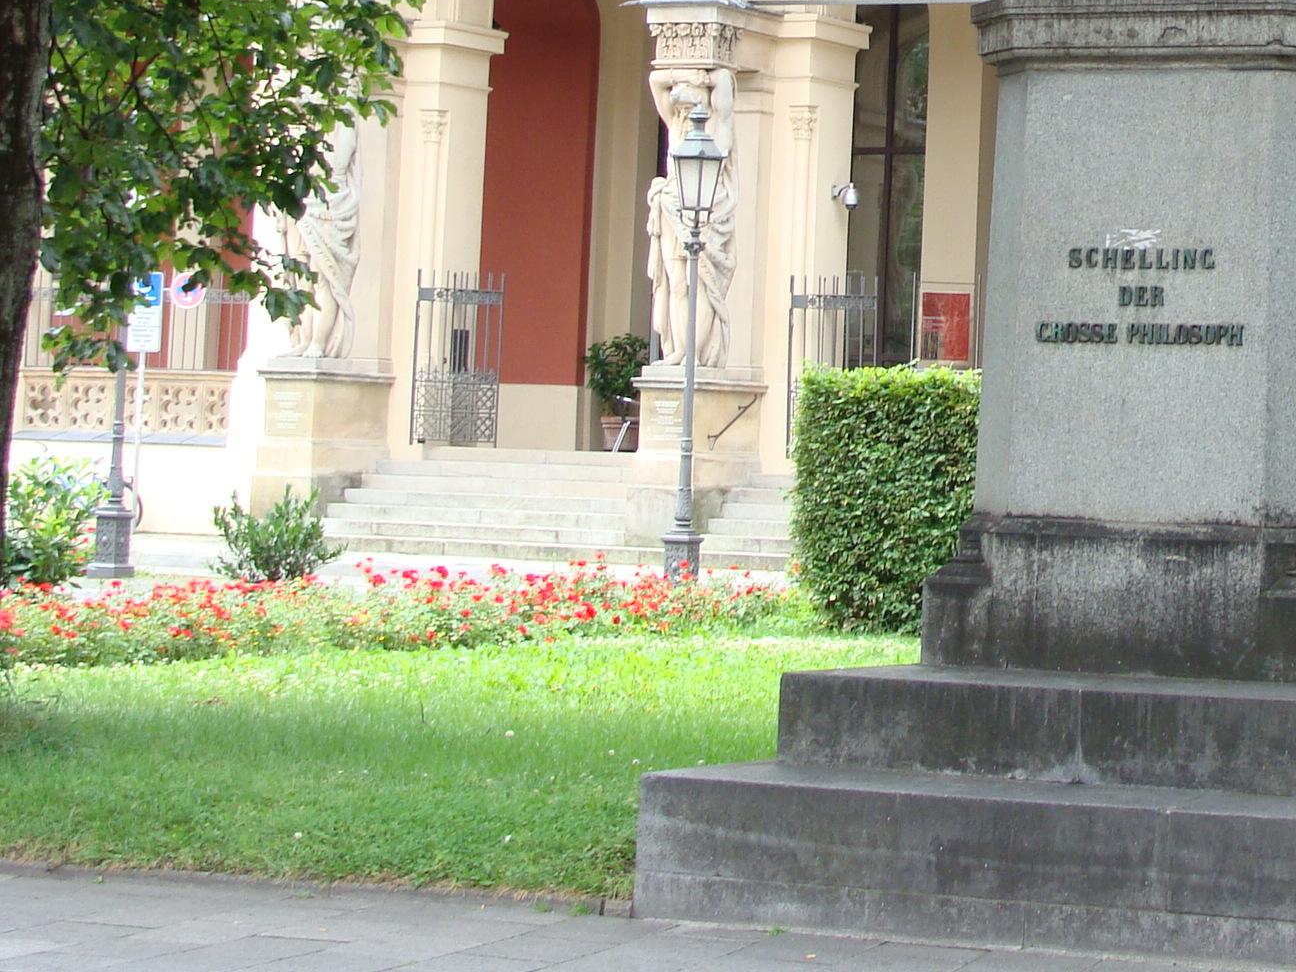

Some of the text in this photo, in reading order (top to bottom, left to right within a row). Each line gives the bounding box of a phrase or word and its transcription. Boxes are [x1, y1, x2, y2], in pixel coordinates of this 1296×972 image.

[1068, 248, 1216, 270] SCHELLING
[1118, 286, 1165, 307] DER
[1035, 322, 1245, 347] GROSSE PHILOSOPH
